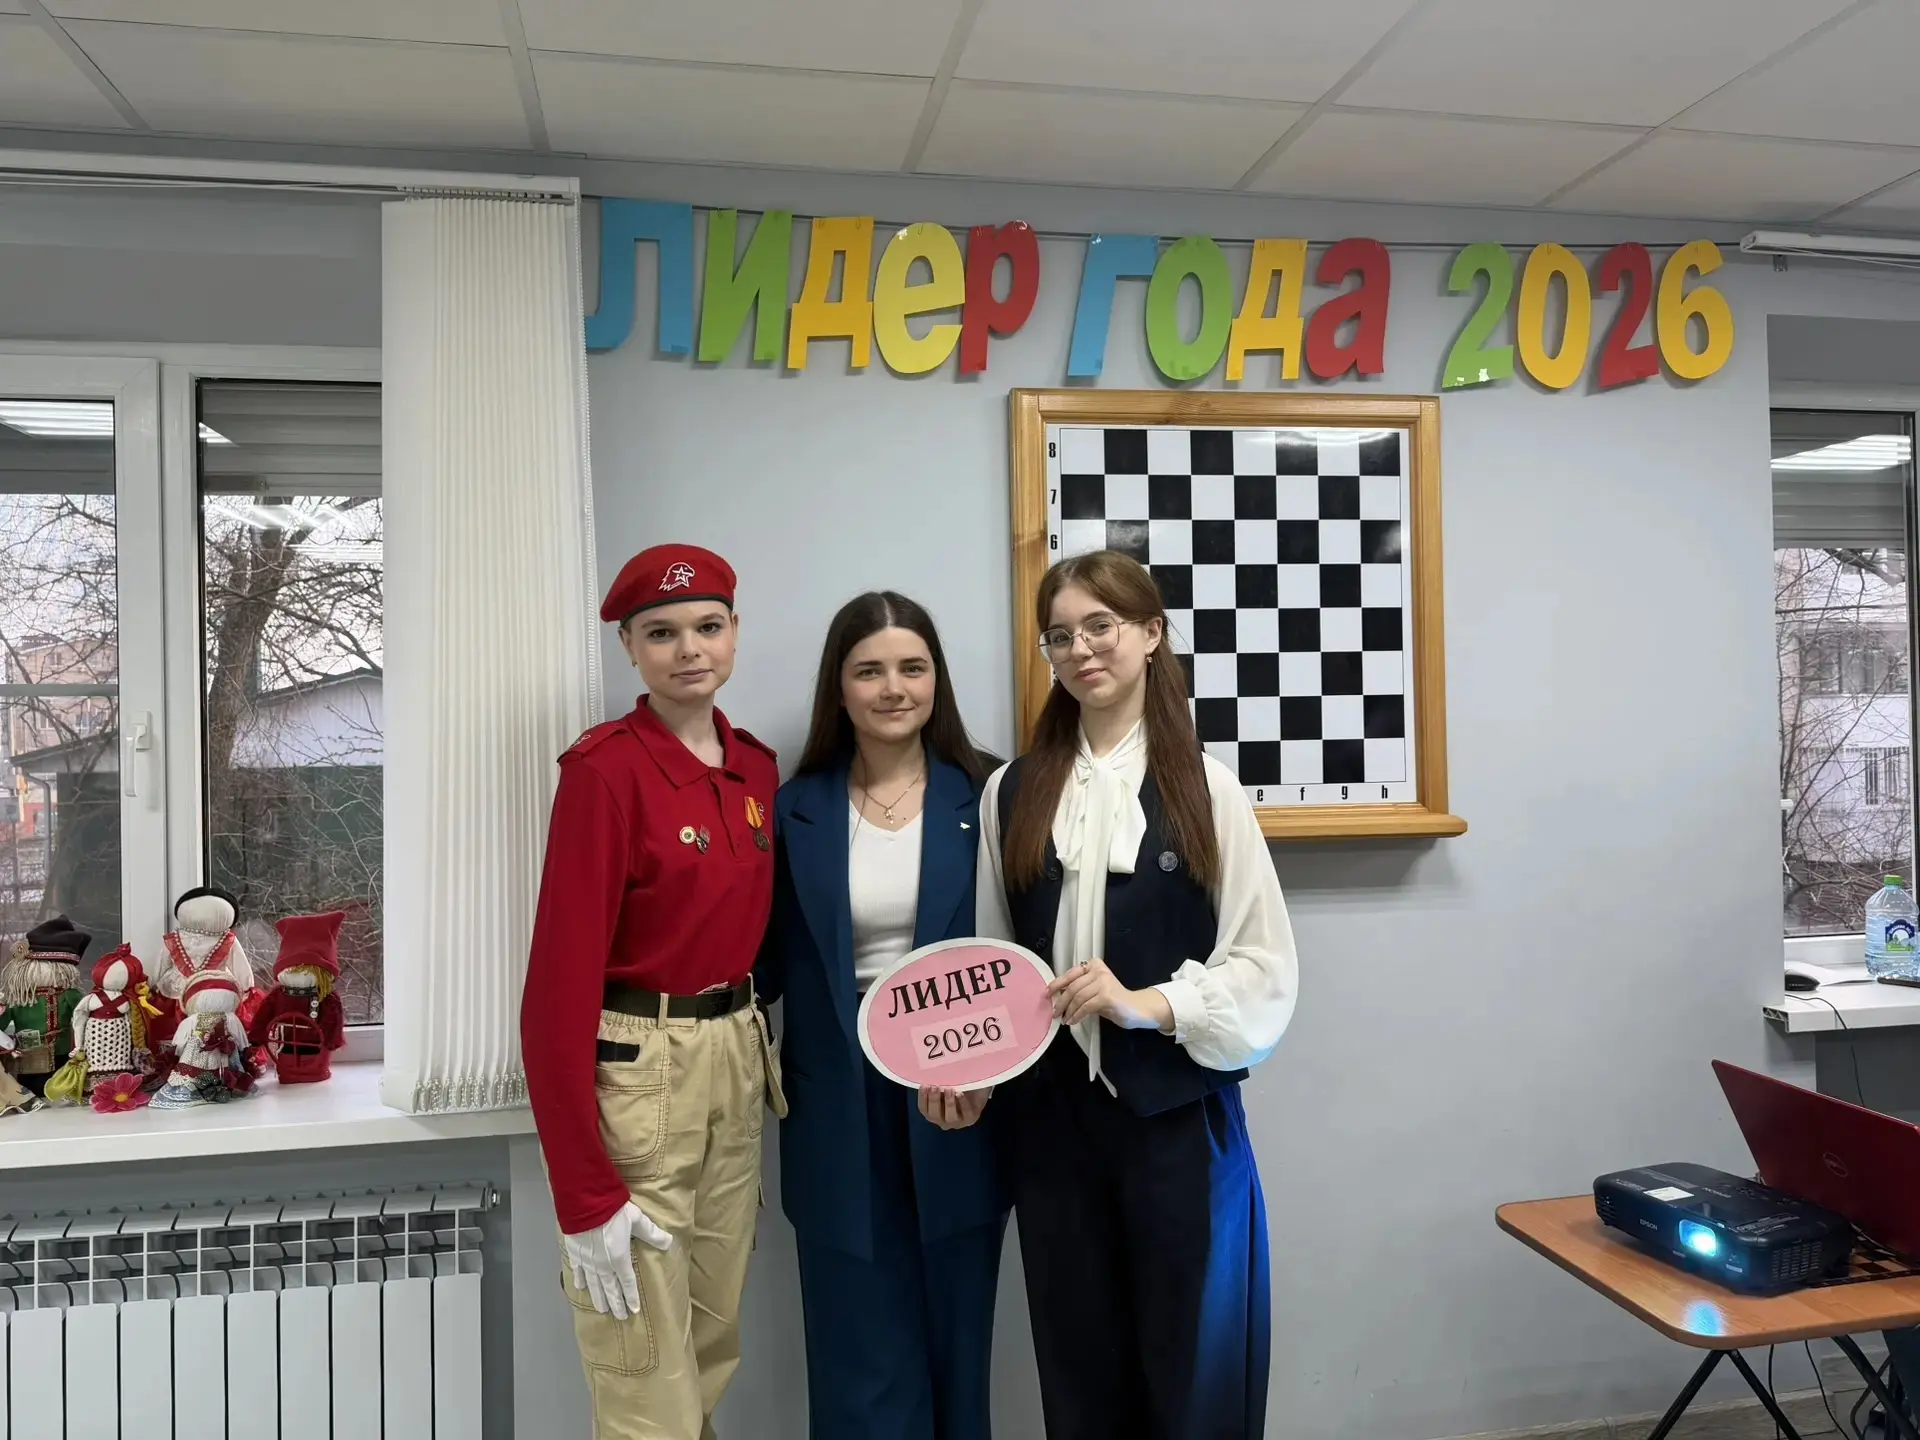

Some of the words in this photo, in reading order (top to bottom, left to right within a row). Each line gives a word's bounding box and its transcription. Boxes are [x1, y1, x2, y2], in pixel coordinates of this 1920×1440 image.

[1441, 239, 1734, 389] 2026
[1048, 442, 1057, 458] 8
[1050, 489, 1057, 504] 7
[1050, 534, 1058, 550] 6
[1256, 788, 1264, 802] e
[1299, 786, 1306, 801] f
[1341, 785, 1348, 800] g
[1381, 784, 1388, 799] h
[888, 958, 1012, 1018] ЛИДЕР
[923, 1016, 1003, 1060] 2026
